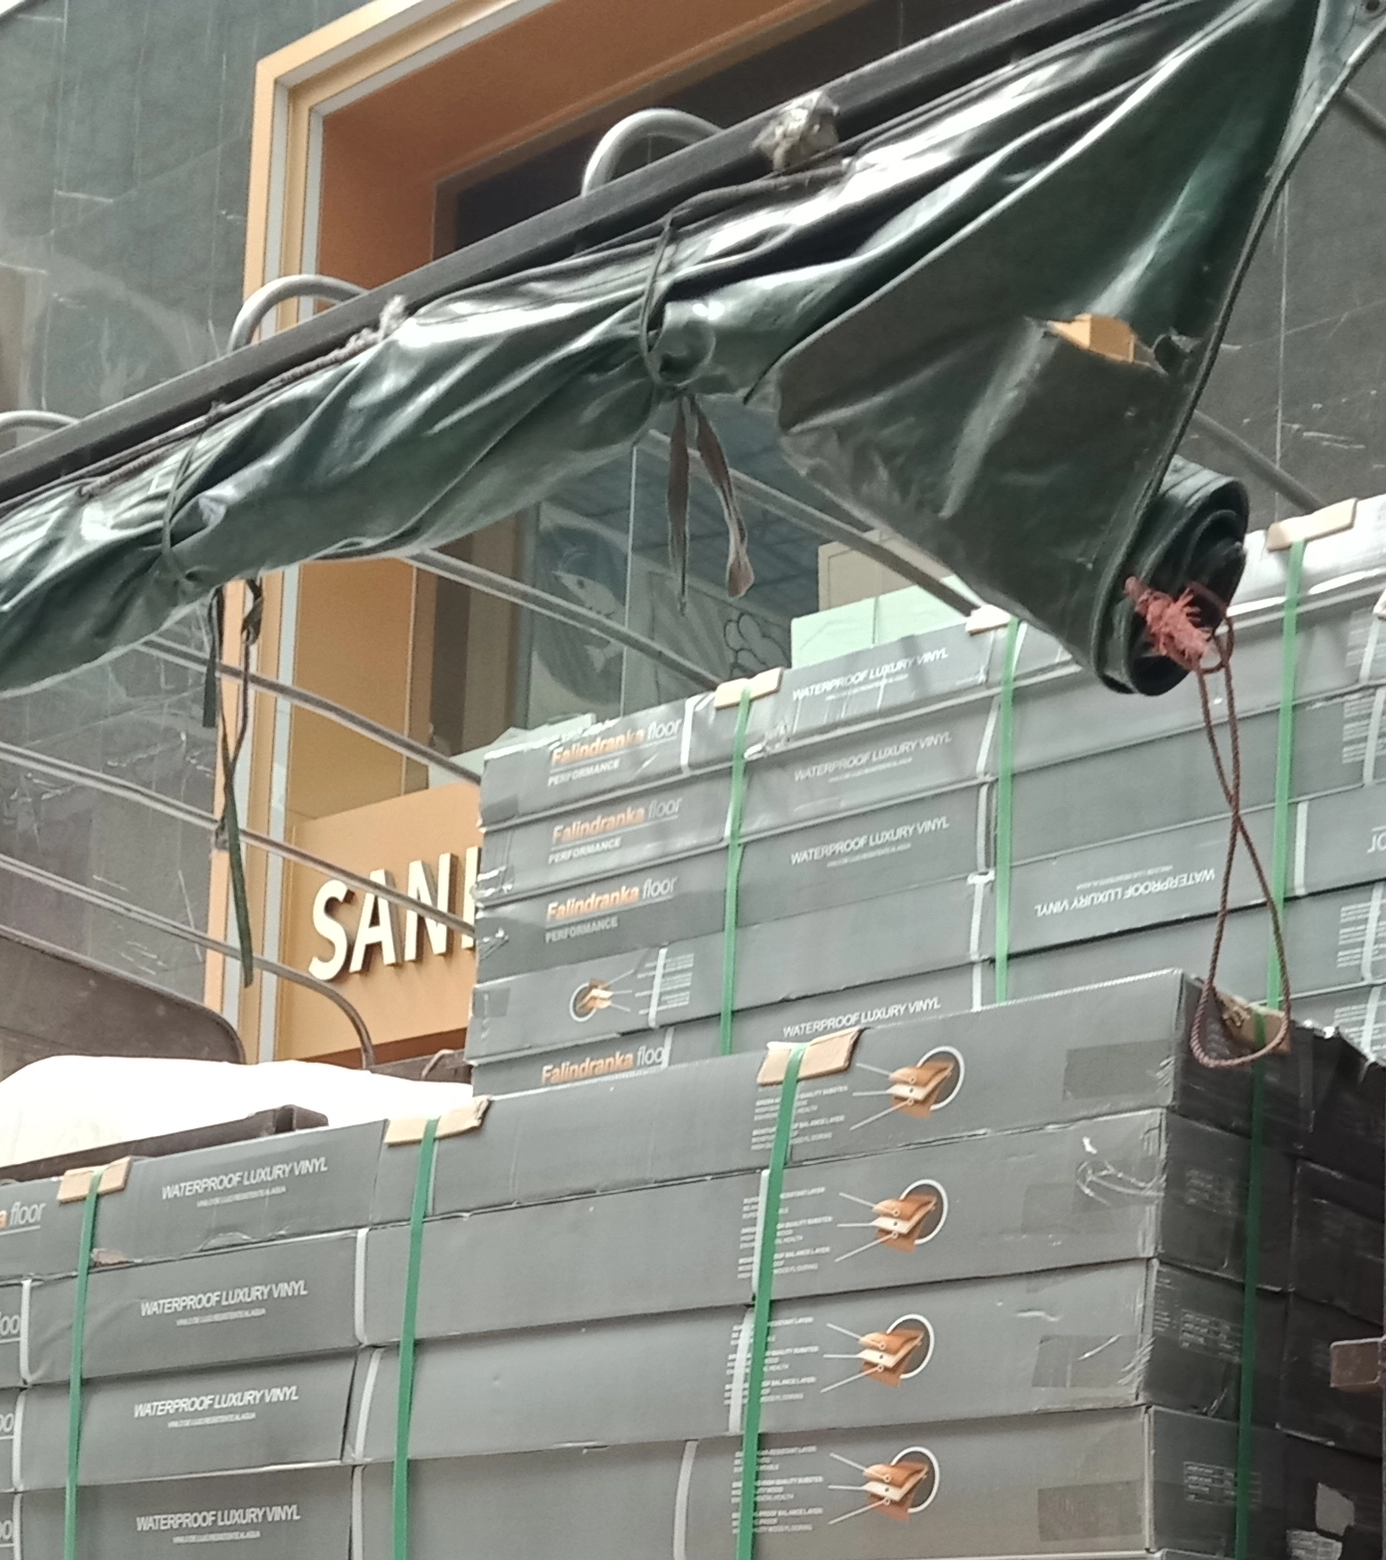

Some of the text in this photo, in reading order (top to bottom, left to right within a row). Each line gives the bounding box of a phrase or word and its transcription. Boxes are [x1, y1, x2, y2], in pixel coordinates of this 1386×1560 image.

[792, 670, 868, 701] WATERPROOF
[868, 657, 914, 680] LUXURY
[916, 647, 948, 666] VINYL
[647, 718, 682, 740] floor
[548, 758, 620, 786] PERFORMANCE
[794, 750, 870, 781] WATERPROOF
[871, 741, 918, 762] LUXURY
[919, 731, 952, 750] VINYL
[552, 797, 683, 844] Falindranka floor
[548, 837, 622, 864] PERFORMANCE
[790, 834, 867, 865] WATERPROOF
[868, 825, 915, 847] LUXURY
[915, 816, 950, 835] VINYL
[546, 876, 679, 921] Falindranka floor
[1070, 886, 1123, 909] LUXURY
[1123, 867, 1215, 899] WATERPROOF
[1034, 898, 1070, 917] VINYL
[545, 916, 618, 943] PERFORMANCE
[782, 996, 941, 1039] WATERPROOF LUXURY VINYL
[541, 1045, 664, 1085] Falindranka floo
[162, 1172, 243, 1200] WATERPROOF
[243, 1163, 293, 1185] LUXURY
[293, 1156, 328, 1177] VINYL
[10, 1201, 46, 1226] floor
[140, 1291, 221, 1317] WATERPROOF
[221, 1285, 271, 1307] LUXURY
[272, 1280, 309, 1299] VINYL
[133, 1385, 300, 1418] WATERPROOF LUXURY VINYL
[136, 1504, 301, 1531] WATERPROOF LUXURY VINYL
